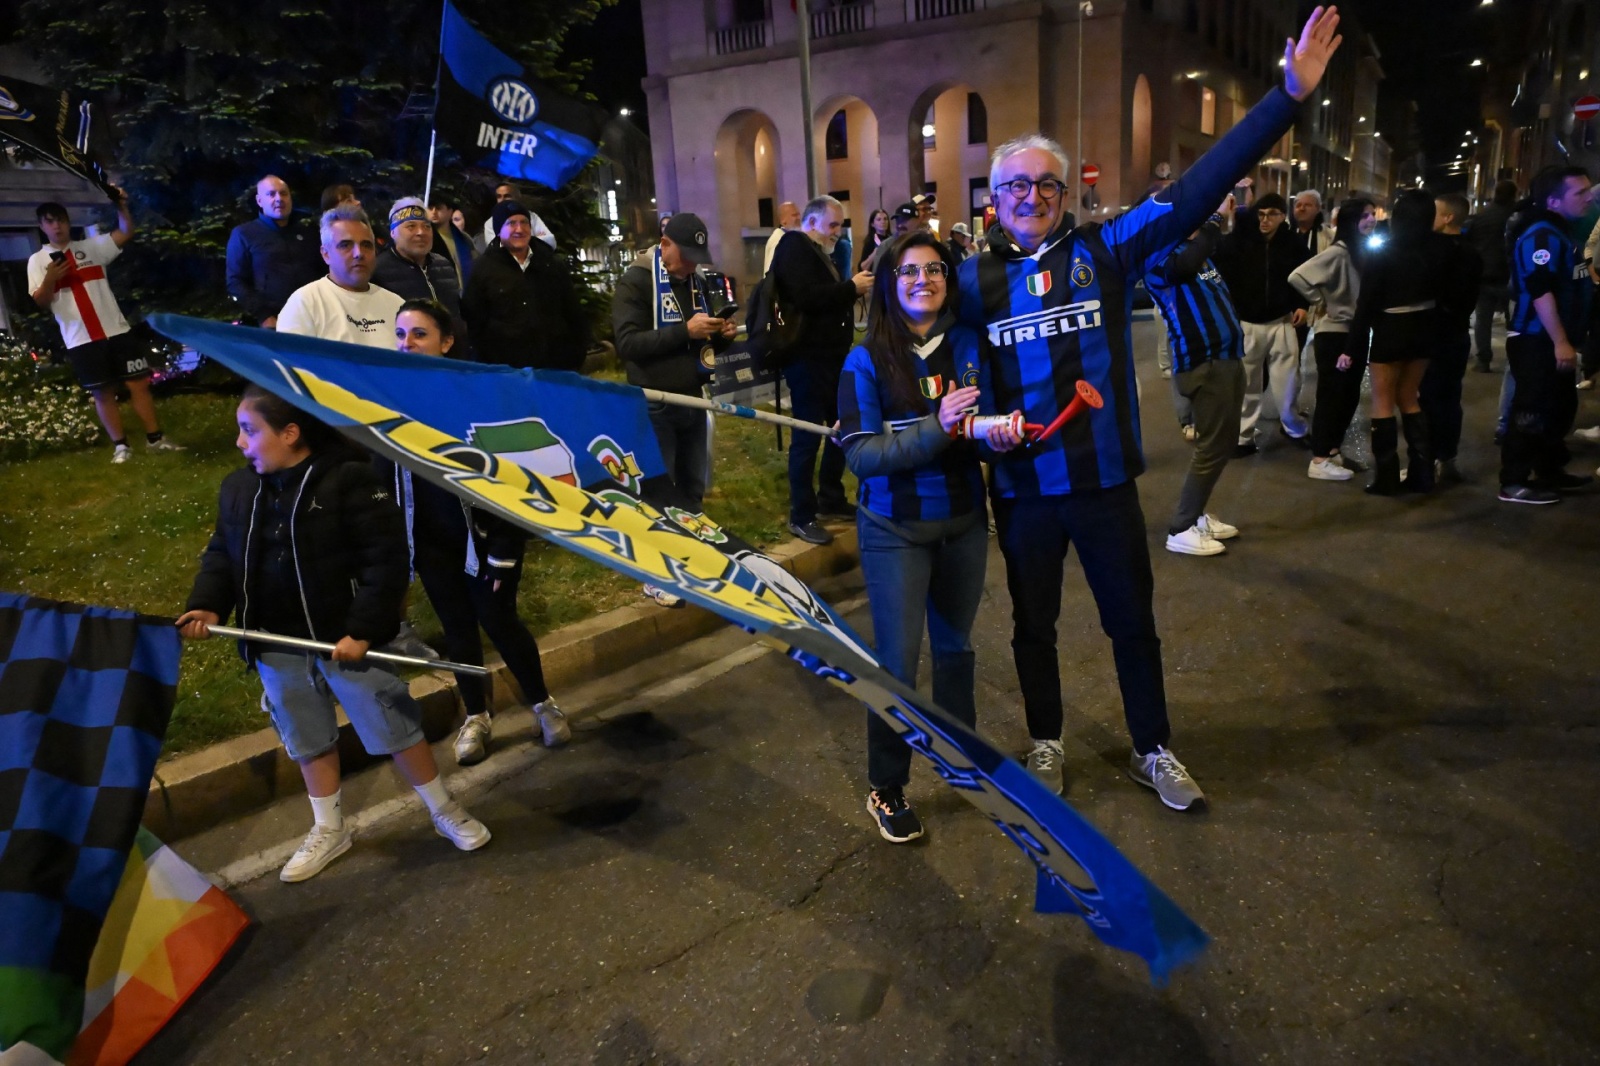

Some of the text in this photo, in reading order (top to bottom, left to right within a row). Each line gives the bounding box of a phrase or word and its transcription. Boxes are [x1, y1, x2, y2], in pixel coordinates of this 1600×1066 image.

[477, 121, 538, 158] INTER
[362, 318, 385, 329] Jeans
[987, 300, 1101, 347] PIRELLI
